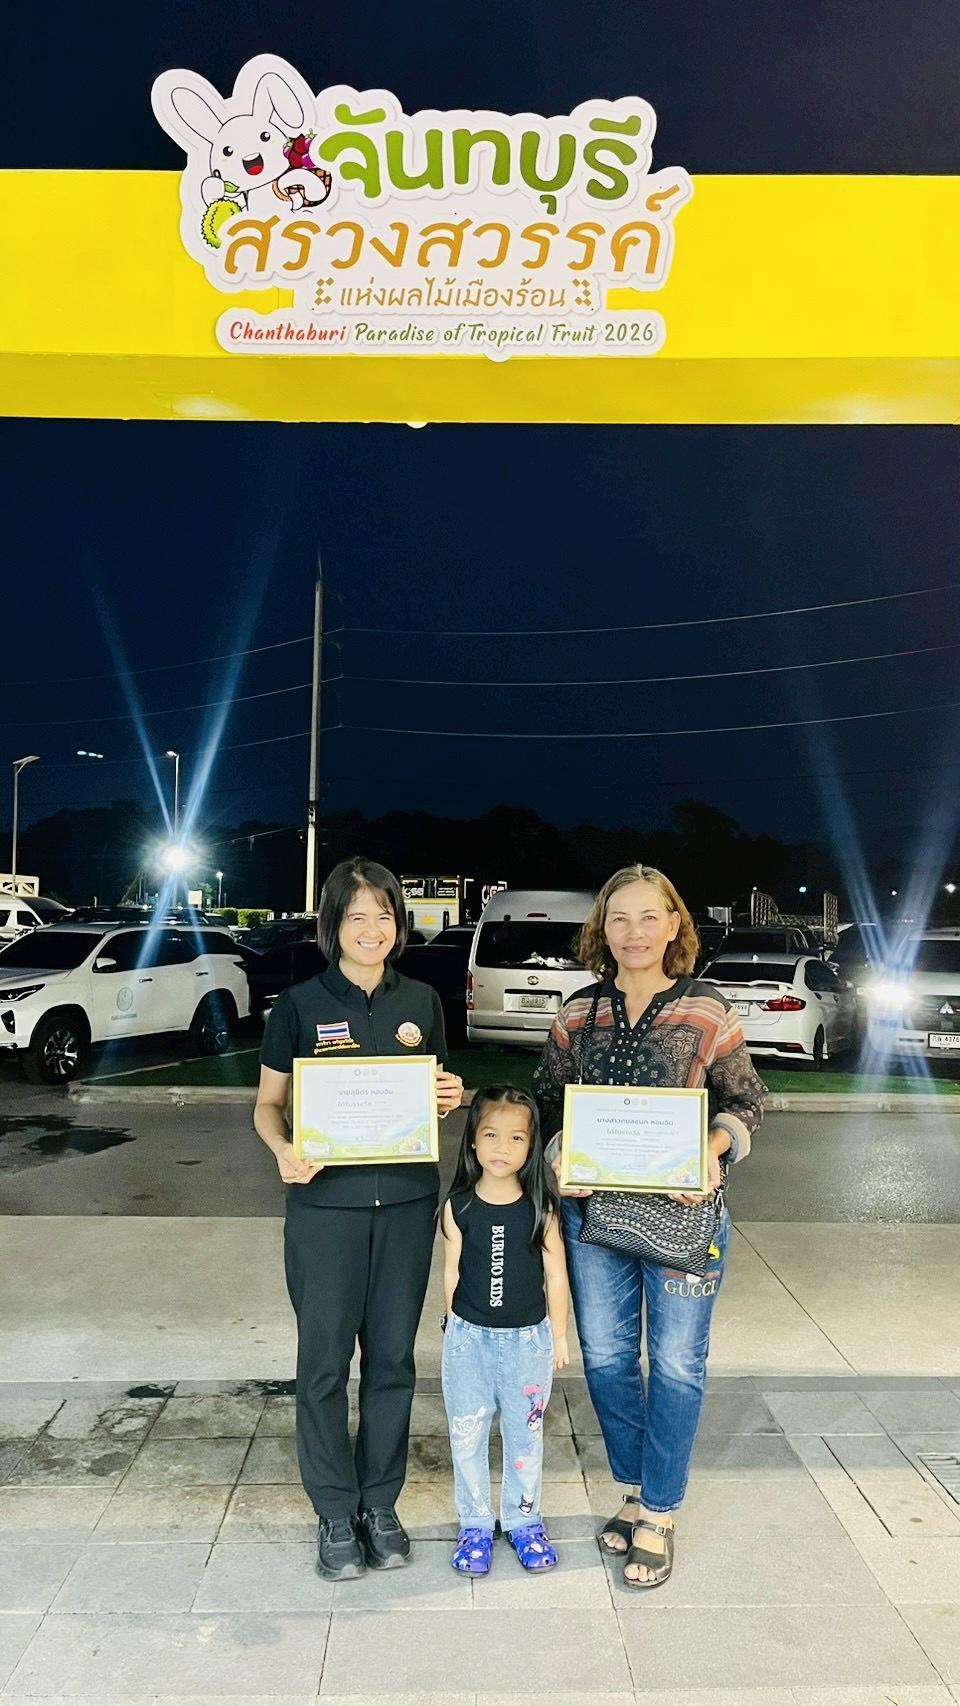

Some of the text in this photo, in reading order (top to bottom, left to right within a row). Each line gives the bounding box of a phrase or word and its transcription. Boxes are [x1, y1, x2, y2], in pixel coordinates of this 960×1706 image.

[318, 103, 642, 215] จันทบุรี
[223, 183, 681, 275] สรวงสวรรค์
[340, 277, 566, 308] แห่งผลไม้เมืองร้อน
[229, 320, 654, 347] Chanthaburi Paradise of Tropical Fruit 2026
[490, 1276, 504, 1308] KIDS
[664, 1279, 717, 1299] GUCCI
